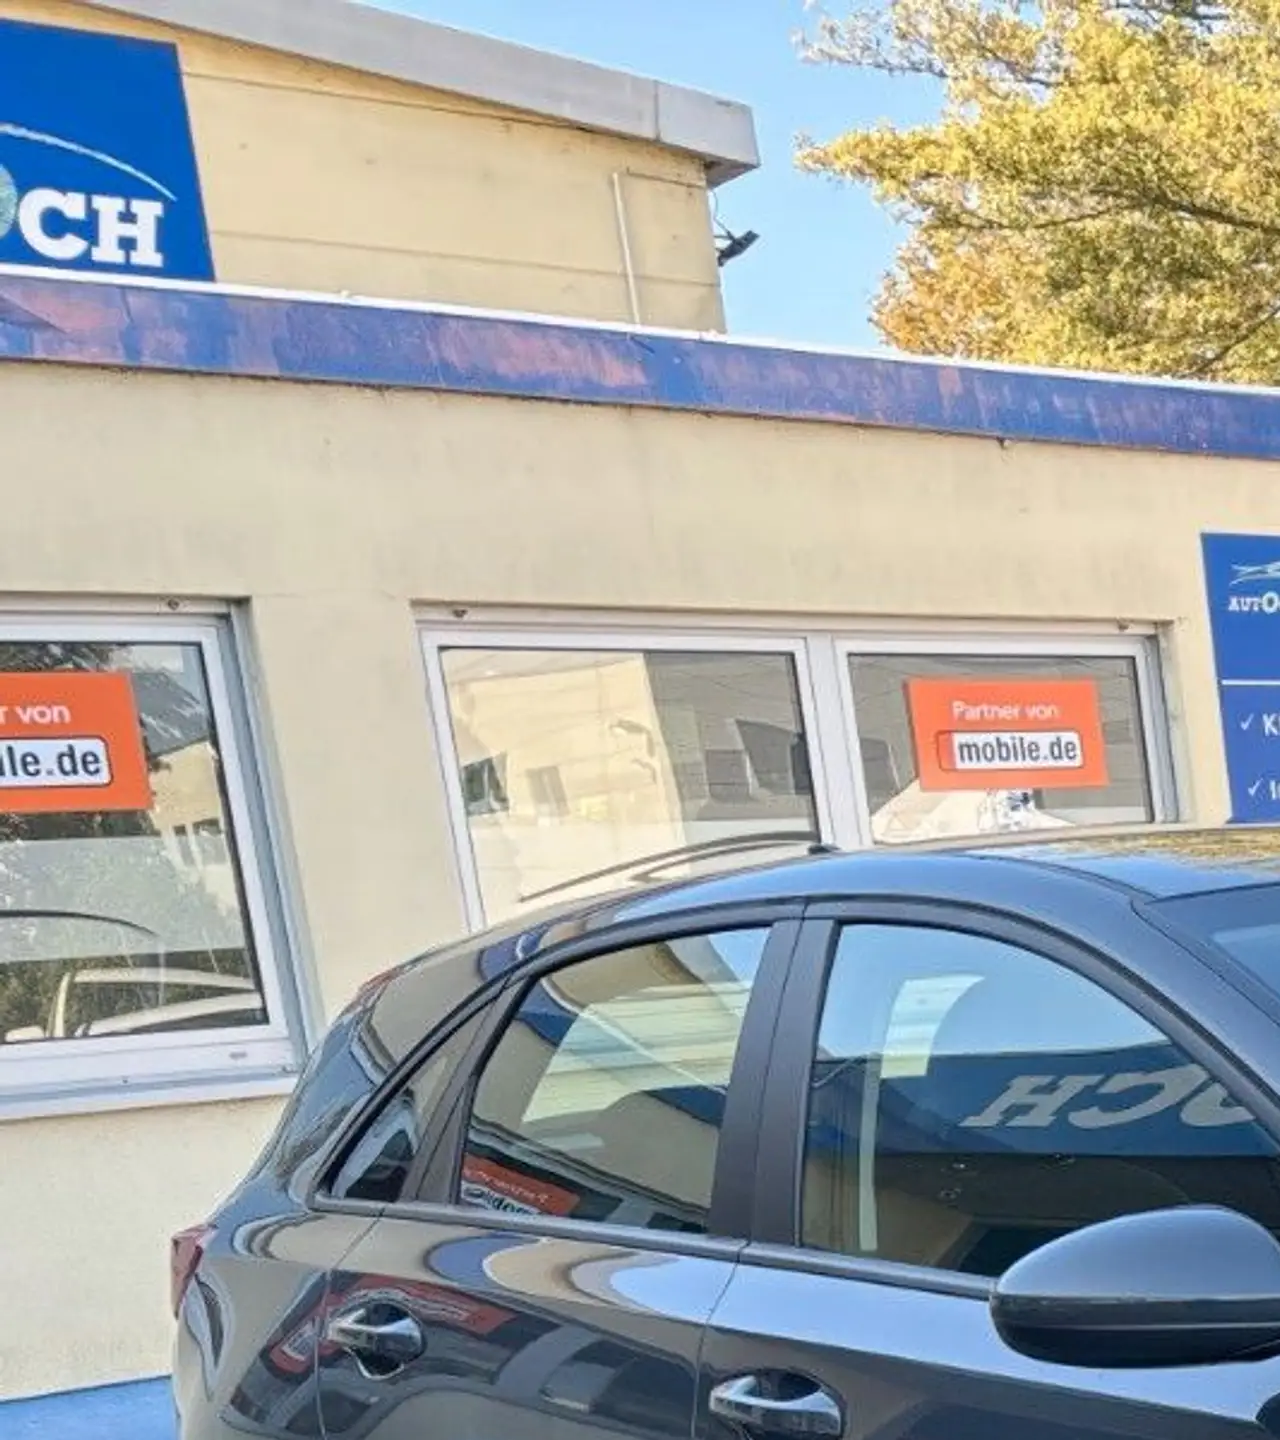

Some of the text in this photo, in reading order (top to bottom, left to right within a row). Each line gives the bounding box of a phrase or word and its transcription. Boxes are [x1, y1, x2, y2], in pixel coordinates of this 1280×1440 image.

[0, 164, 164, 267] CH
[14, 704, 71, 724] von
[952, 700, 1060, 721] Partner von
[957, 736, 1078, 763] mobile.de
